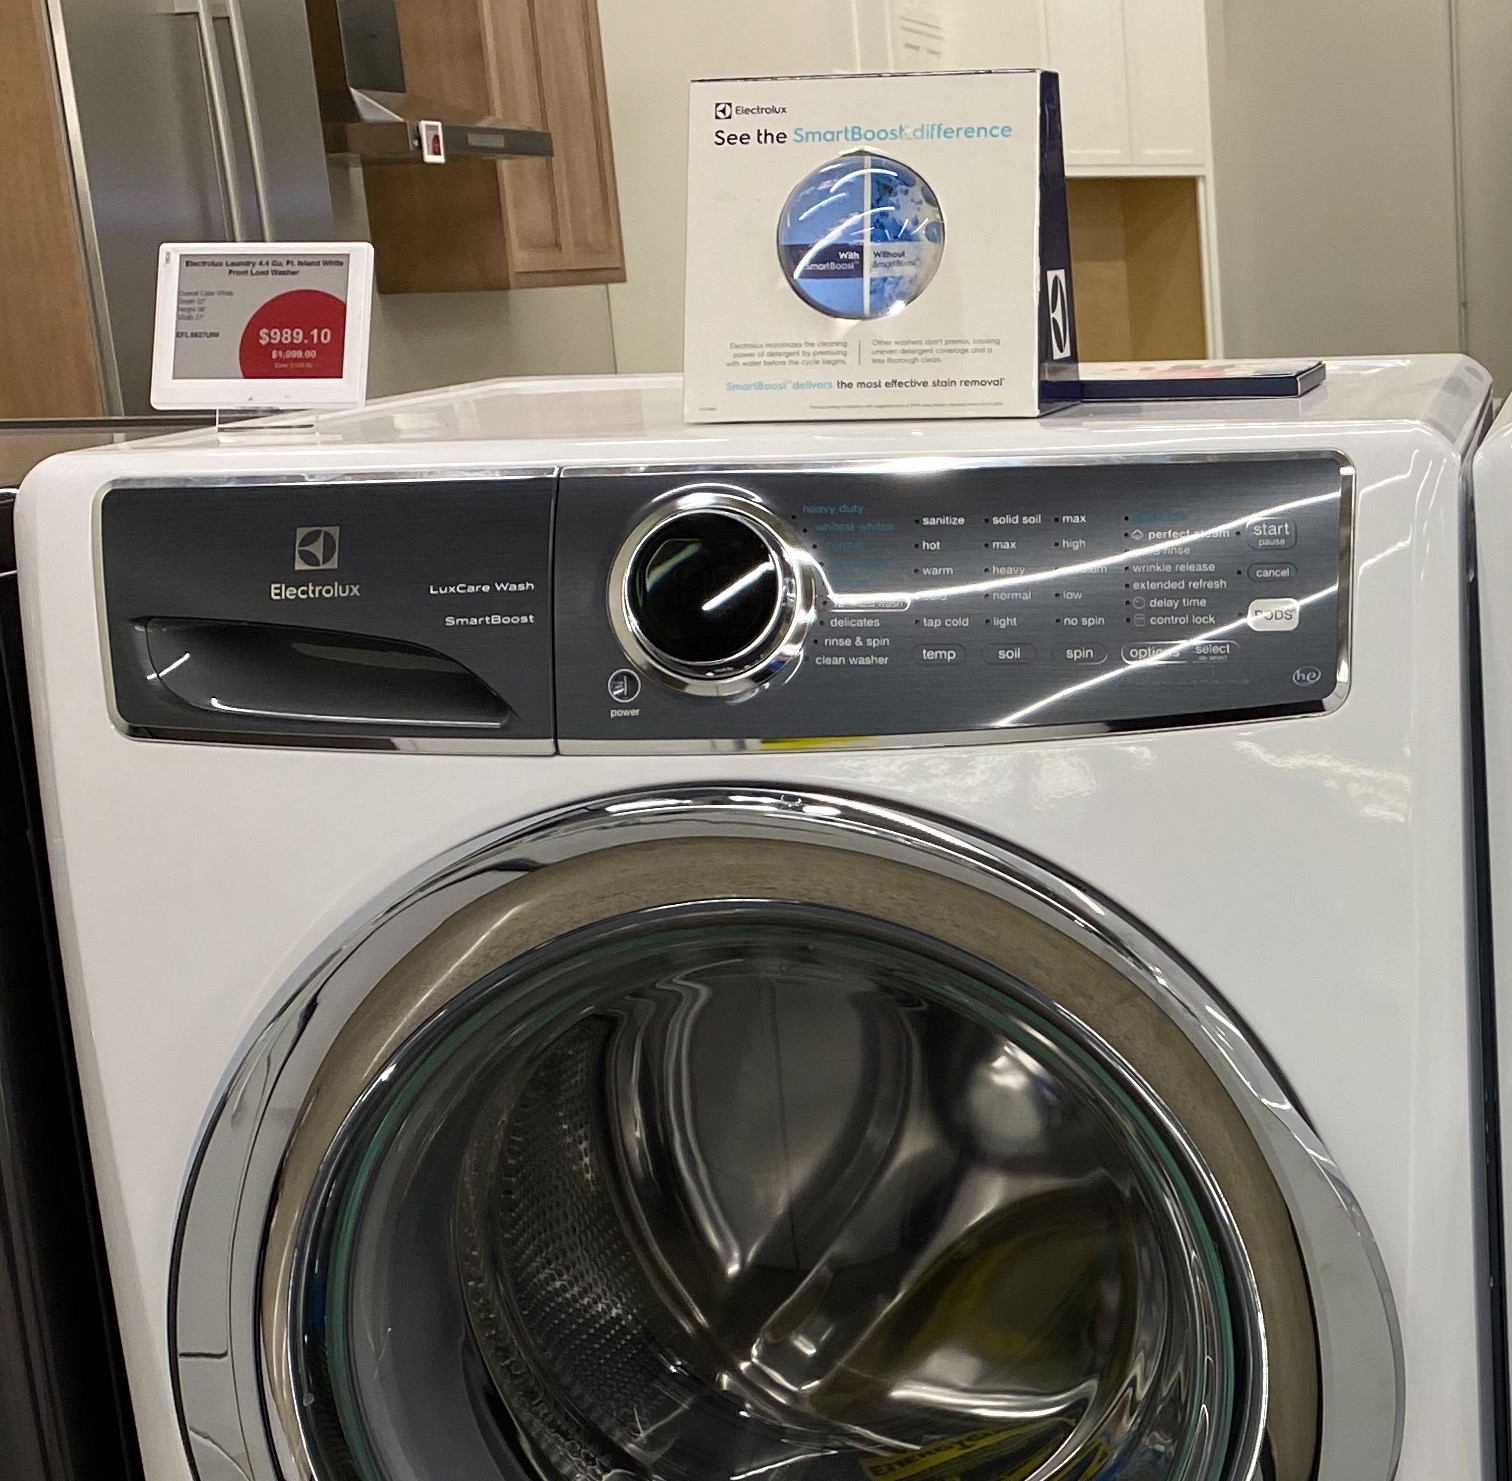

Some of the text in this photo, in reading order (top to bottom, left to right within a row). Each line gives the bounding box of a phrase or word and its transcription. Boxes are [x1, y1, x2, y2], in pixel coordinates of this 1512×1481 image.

[735, 105, 787, 116] Electrolux
[714, 129, 750, 146] See
[756, 128, 788, 144] the
[913, 123, 1012, 140] difference
[258, 327, 332, 345] $989.10
[792, 380, 833, 390] delivers
[836, 380, 854, 389] the
[856, 380, 882, 388] most
[885, 379, 929, 388] effective
[931, 378, 957, 387] stain
[922, 514, 965, 526] sanitize
[992, 513, 1041, 525] solid soil
[1062, 514, 1087, 524] max
[1148, 529, 1231, 541] perfect eam
[1253, 522, 1290, 536] start
[922, 540, 941, 551] hot
[992, 540, 1017, 550] max
[1062, 538, 1086, 550] high
[1258, 537, 1286, 548] pause
[922, 566, 954, 576] warm
[992, 564, 1026, 576] heavy
[1132, 561, 1216, 573] wrinkle release
[1255, 567, 1290, 577] cancel
[270, 581, 361, 600] Electrolux
[429, 581, 535, 596] LuxCare Wash
[1132, 579, 1227, 590] extended refresh
[992, 590, 1032, 600] normal
[1063, 589, 1083, 600] low
[1149, 596, 1207, 610] delay time
[444, 613, 535, 627] SmartBoost
[830, 616, 881, 628] delicates
[923, 616, 969, 629] tap cold
[993, 616, 1017, 628] light
[1063, 614, 1105, 627] no spin
[1150, 613, 1216, 625] control lock
[824, 636, 890, 649] rinse & spin
[922, 648, 956, 662] temp
[998, 647, 1021, 660] soil
[1066, 647, 1094, 661] spin
[1195, 643, 1231, 655] select
[815, 654, 889, 666] clean washer
[610, 707, 640, 720] power
